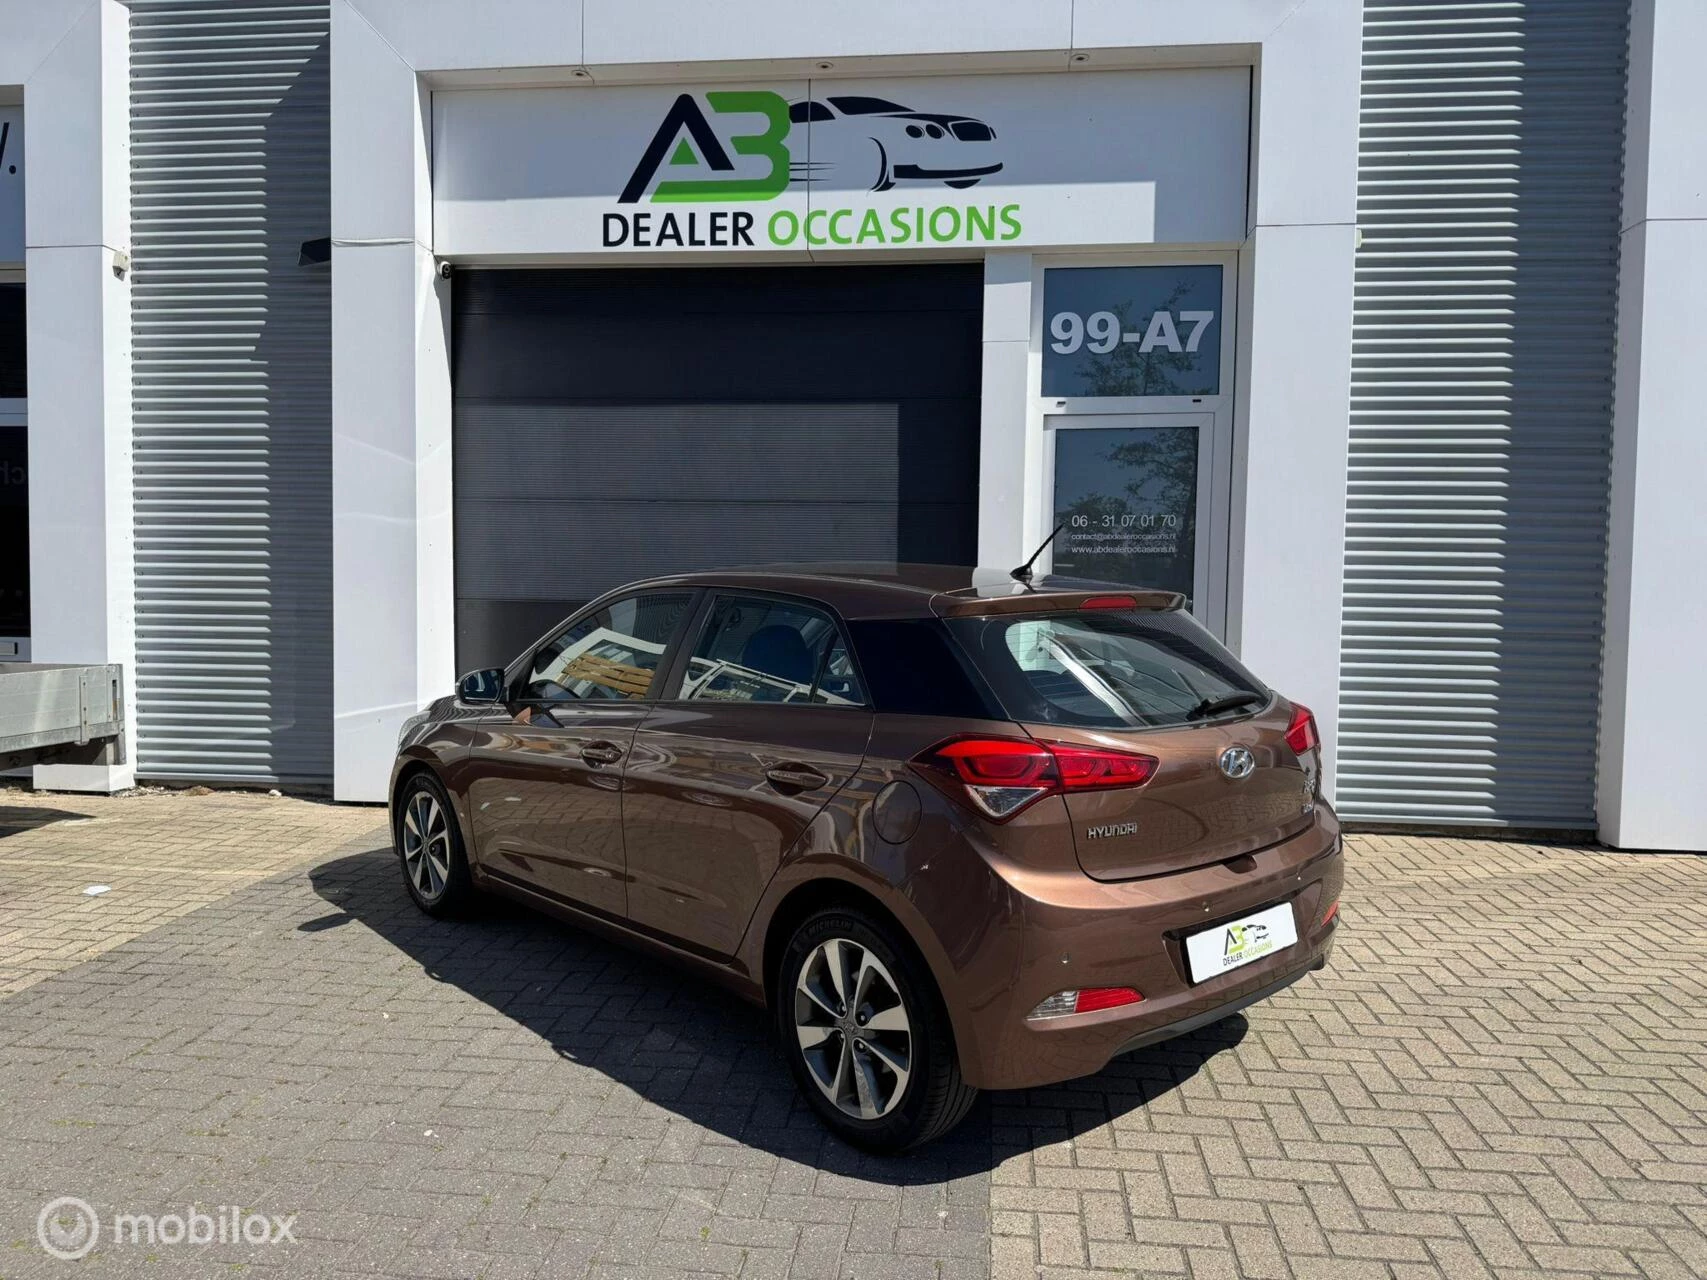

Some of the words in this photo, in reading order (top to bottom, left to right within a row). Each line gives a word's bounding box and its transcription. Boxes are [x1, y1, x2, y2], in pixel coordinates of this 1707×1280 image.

[602, 211, 755, 247] DEALER
[767, 203, 1022, 246] OCCASIONS
[1050, 310, 1214, 354] 99-A7
[1071, 515, 1088, 527] 06
[1101, 515, 1115, 527] 31
[1120, 514, 1136, 527] 07
[1140, 514, 1155, 527] 01
[1160, 514, 1177, 527] 70
[1071, 544, 1176, 554] www.abdealeroccasions.nl
[1087, 822, 1138, 839] HYUNDAI
[1222, 951, 1243, 966] DEALER
